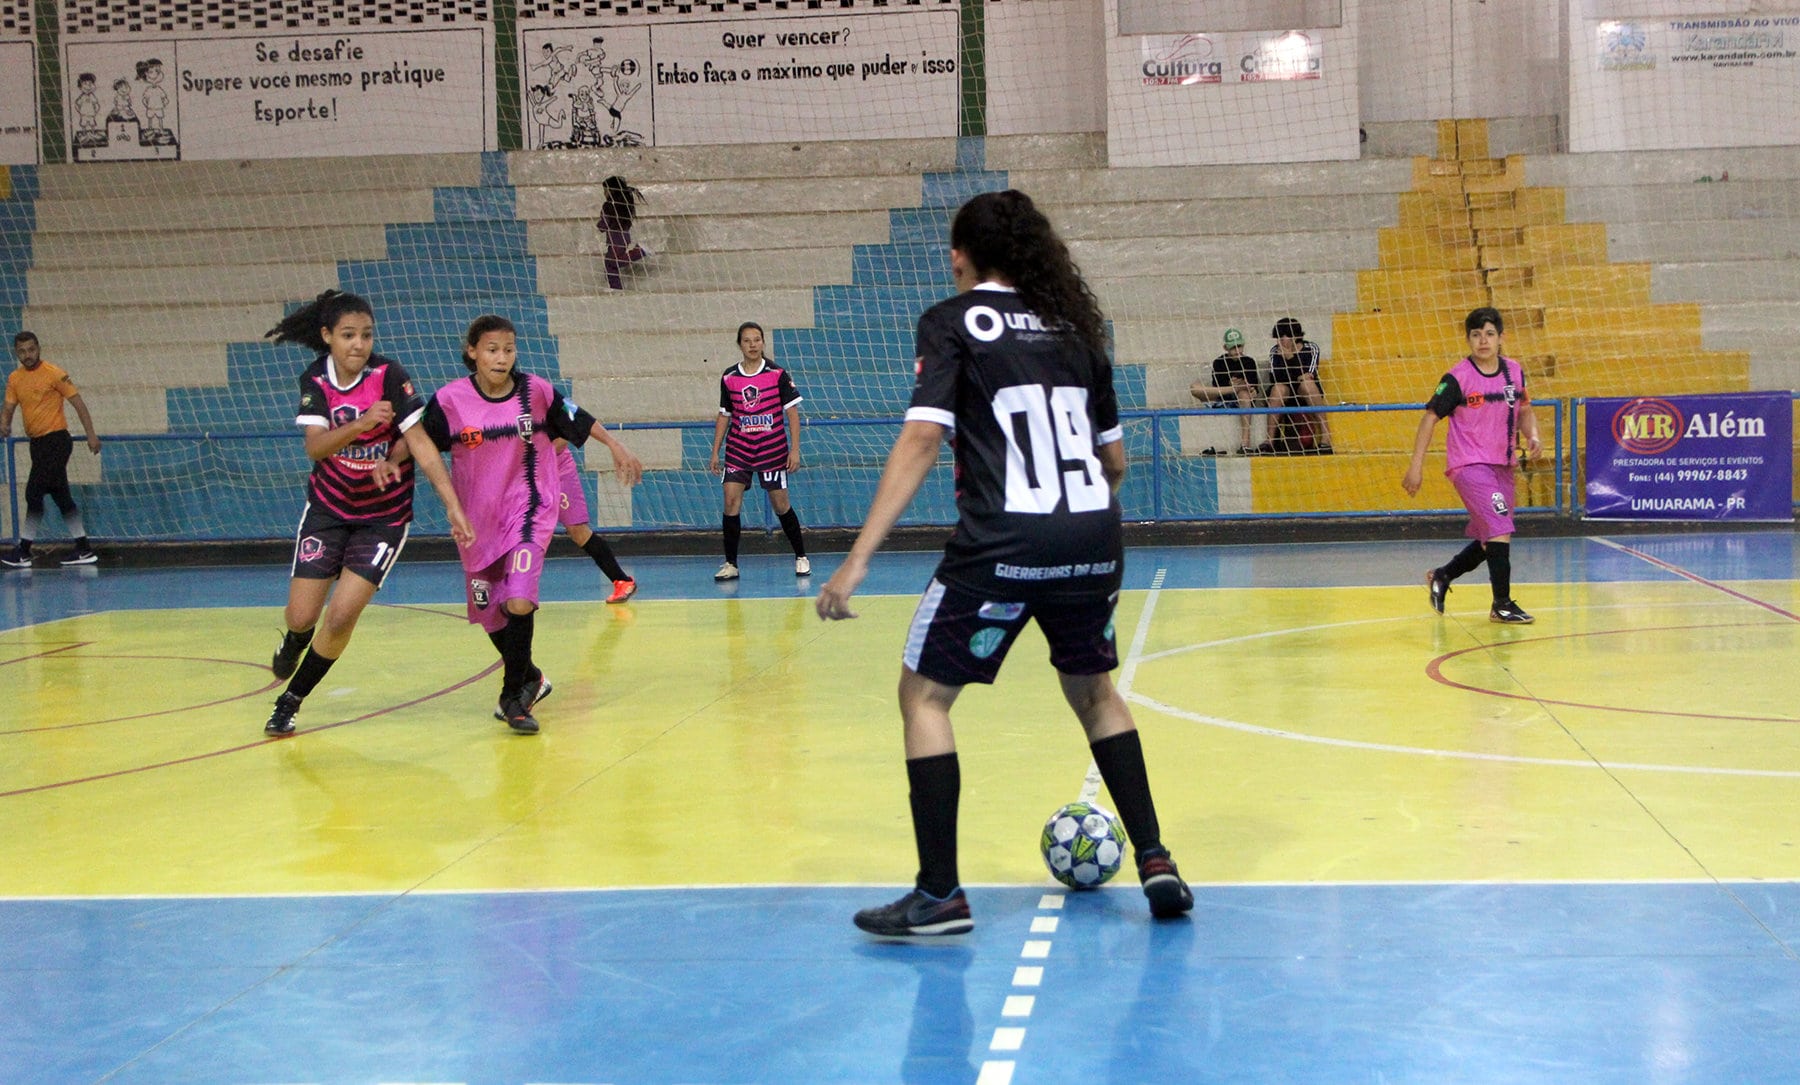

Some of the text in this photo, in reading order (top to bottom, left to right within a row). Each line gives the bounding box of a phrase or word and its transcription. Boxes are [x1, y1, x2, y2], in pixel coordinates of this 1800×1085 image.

[1670, 17, 1800, 29] TRANSMISSÃO AO VIVO
[722, 27, 850, 49] Quer vencer?
[256, 38, 363, 62] Se desafie
[1671, 50, 1796, 62] www.karandafm.com.br
[183, 70, 242, 96] Supere
[296, 72, 352, 88] mesmo
[361, 60, 445, 91] pratique
[704, 60, 737, 84] faça
[741, 69, 751, 80] o
[826, 62, 855, 81] que
[862, 53, 907, 81] puder
[922, 50, 955, 74] isso
[1143, 60, 1222, 77] Cultura
[255, 97, 337, 126] Esporte!
[1622, 411, 1766, 440] MR Além
[991, 384, 1110, 514] 09
[1613, 456, 1763, 467] PRESTADORA DE SERVIÇOS E EVENTOS
[1654, 472, 1674, 484] (44)
[1677, 469, 1748, 482] 99967-8843
[1631, 498, 1715, 511] UMUARAMA
[1727, 497, 1746, 509] PR
[371, 541, 395, 571] 11
[511, 548, 532, 574] 10
[994, 560, 1117, 580] GUERREIRAS DA BOLA
